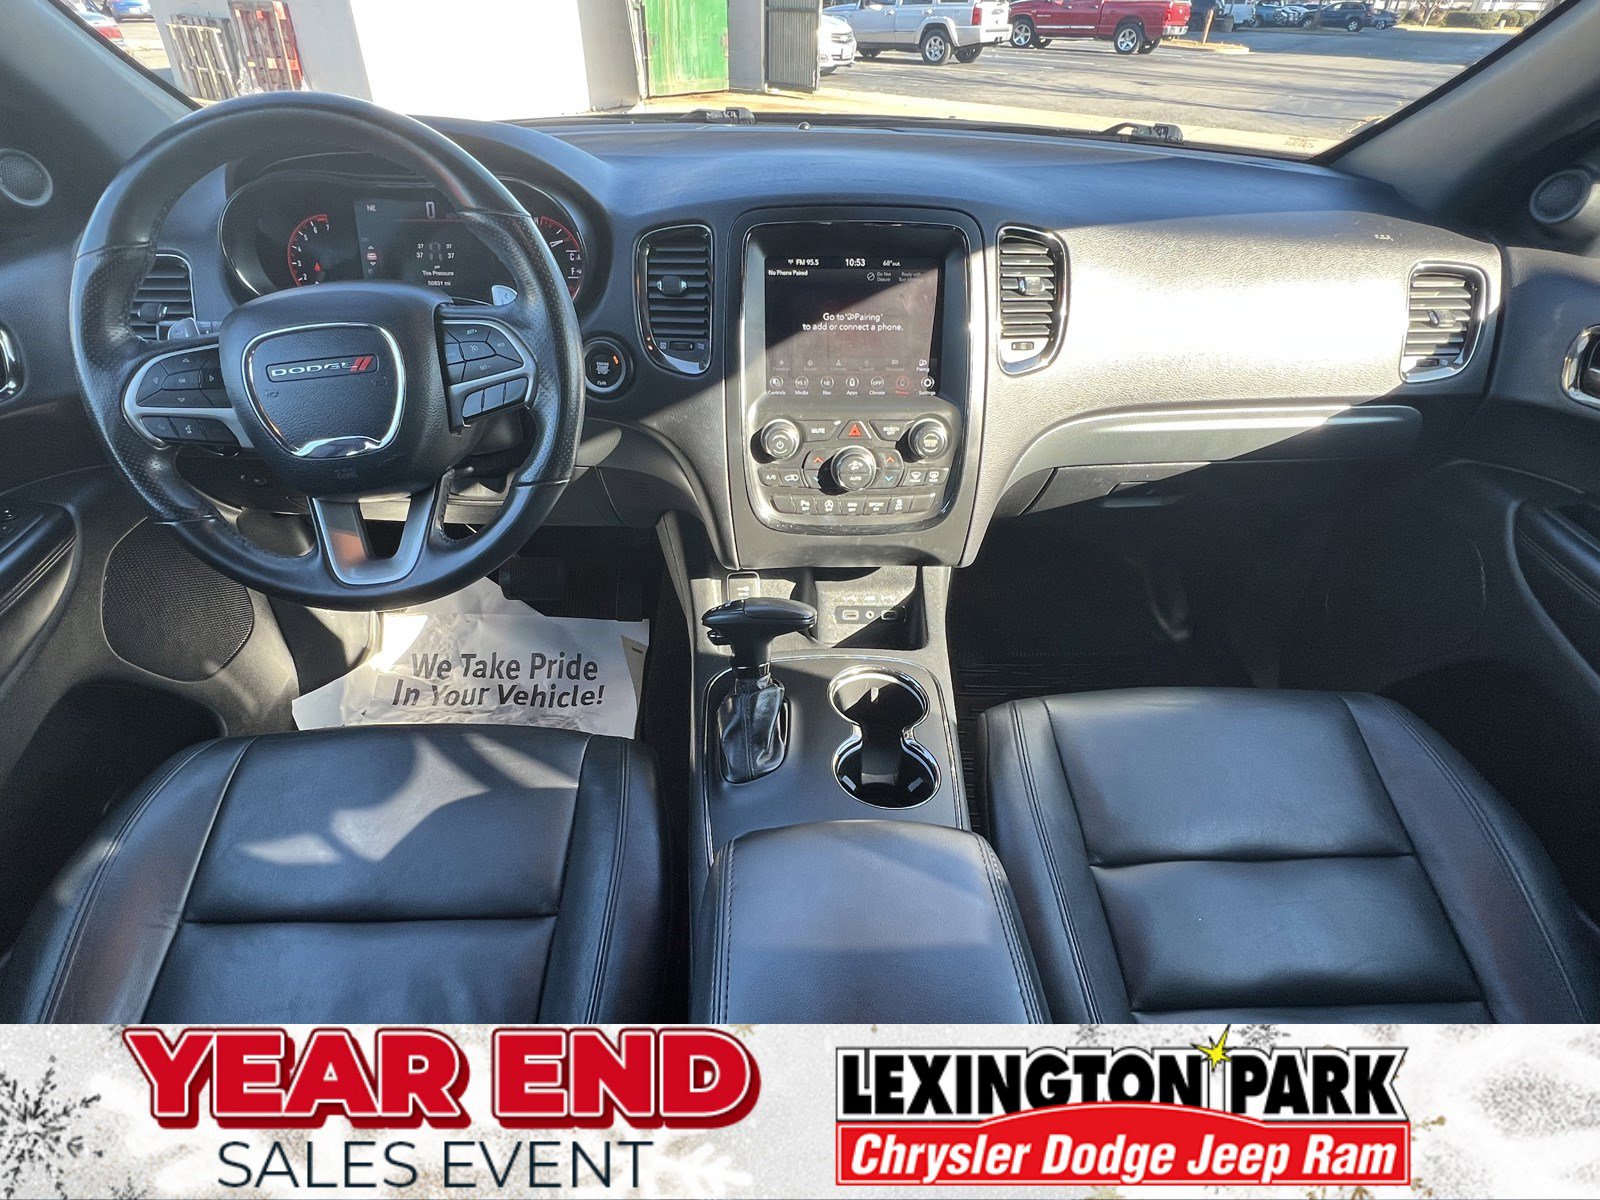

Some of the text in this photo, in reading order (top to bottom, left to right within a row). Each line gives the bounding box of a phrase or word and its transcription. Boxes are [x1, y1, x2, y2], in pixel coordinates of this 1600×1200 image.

[366, 204, 376, 212] NE
[569, 253, 575, 261] C
[795, 258, 820, 266] FM 95.5
[845, 258, 866, 267] 10:53
[570, 267, 576, 276] F
[303, 273, 308, 281] 2
[822, 312, 835, 321] Go
[836, 313, 845, 321] to
[802, 323, 811, 331] to
[812, 322, 828, 331] add
[839, 323, 869, 331] connect
[877, 322, 904, 333] phone.
[271, 362, 353, 377] DODGE
[411, 651, 599, 681] We Take Pride
[391, 678, 606, 709] In Your Vehicle!
